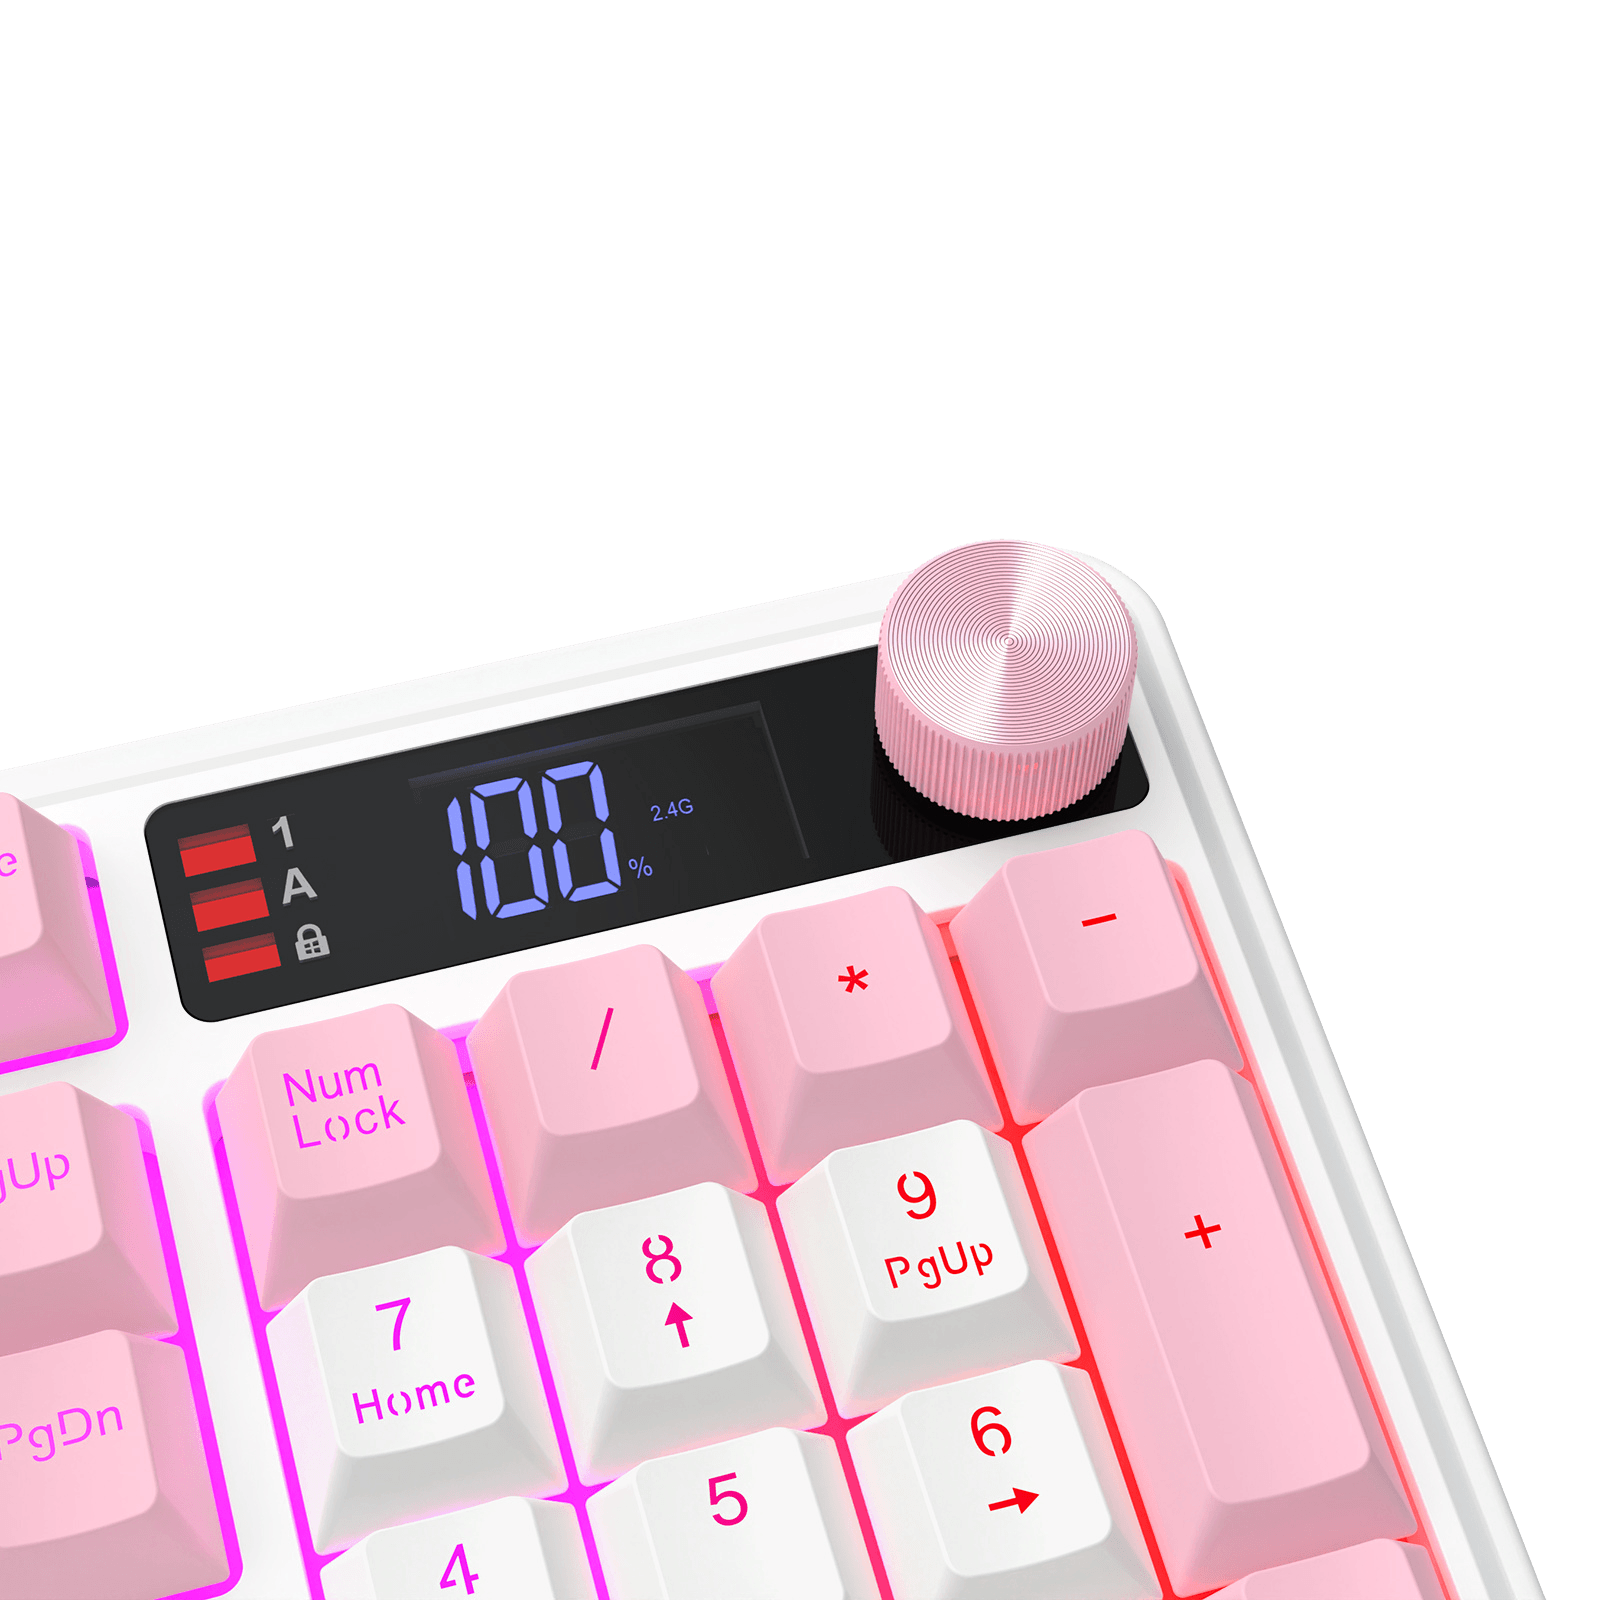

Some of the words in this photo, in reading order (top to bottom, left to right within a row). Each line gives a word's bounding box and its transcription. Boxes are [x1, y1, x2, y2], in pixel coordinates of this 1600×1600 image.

[271, 815, 294, 849] 1
[650, 798, 694, 822] 2.4G
[282, 866, 318, 906] A
[282, 1062, 383, 1107] Num
[292, 1094, 406, 1149] Lock
[0, 1151, 70, 1204] Up
[896, 1170, 937, 1220] 9
[641, 1234, 682, 1285] 8
[884, 1241, 993, 1290] PgUp
[374, 1296, 411, 1352] 7
[351, 1373, 475, 1425] Home
[970, 1405, 1012, 1457] 6
[708, 1471, 749, 1527] 5
[439, 1543, 480, 1596] 4
